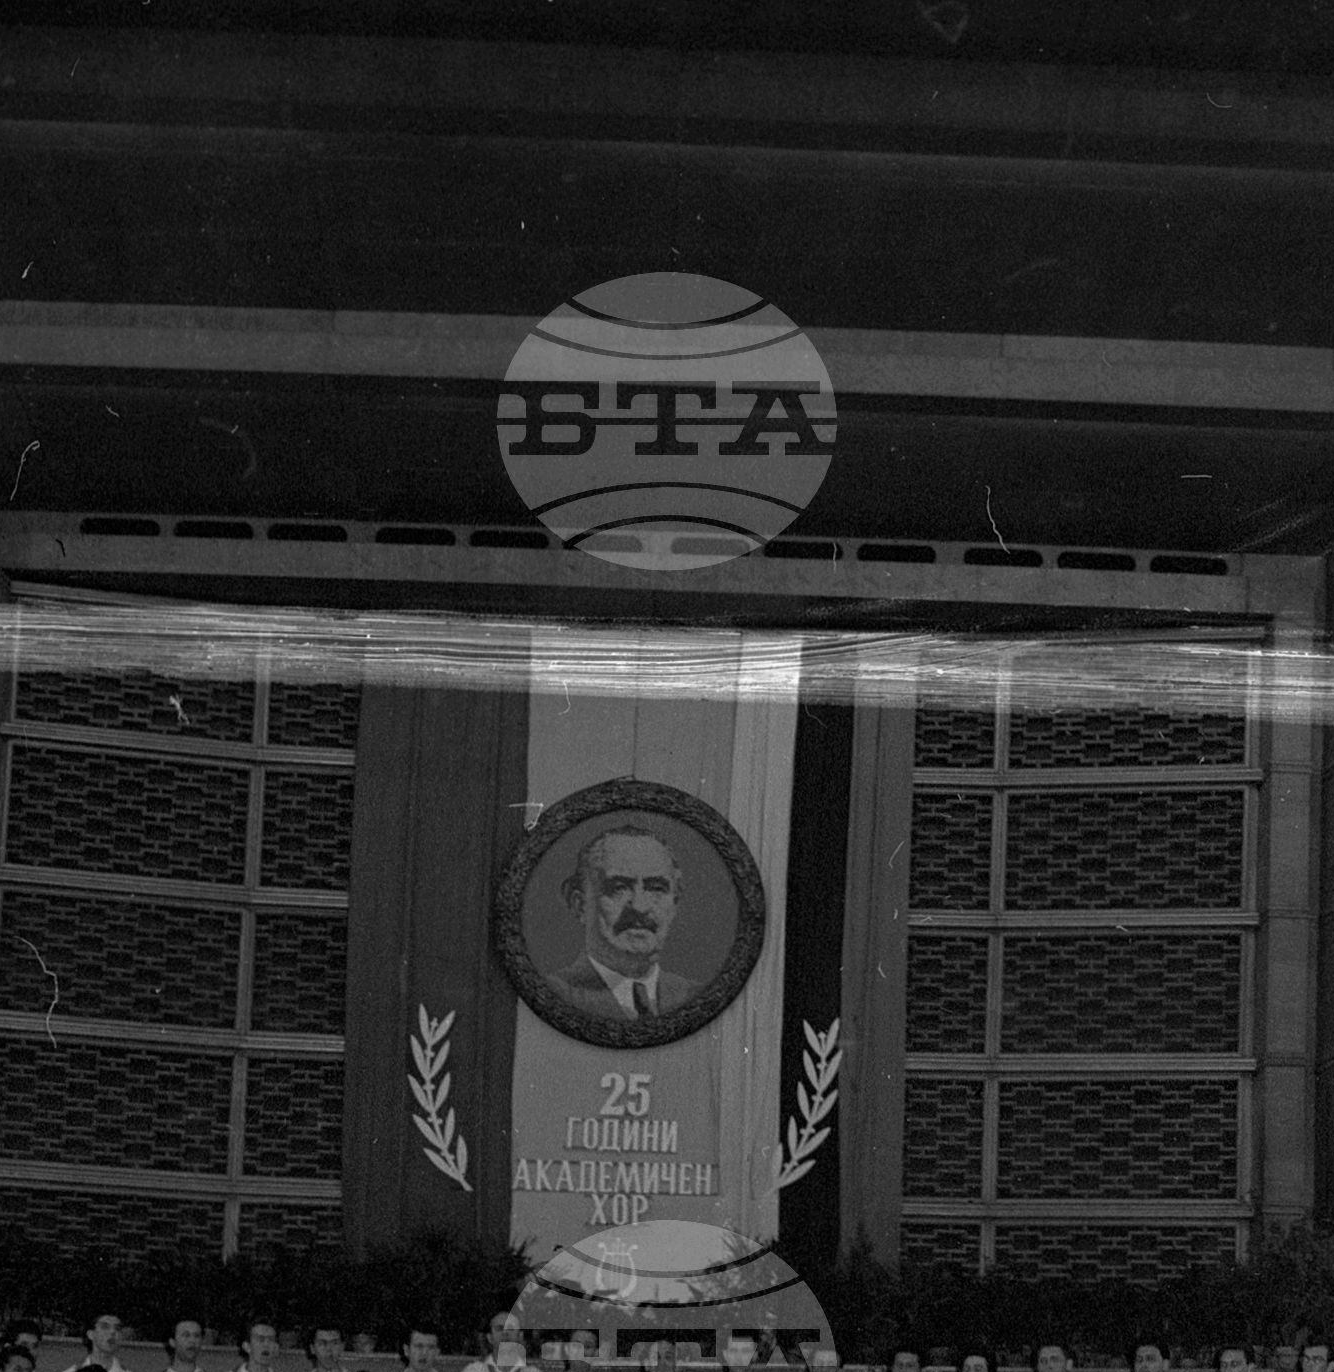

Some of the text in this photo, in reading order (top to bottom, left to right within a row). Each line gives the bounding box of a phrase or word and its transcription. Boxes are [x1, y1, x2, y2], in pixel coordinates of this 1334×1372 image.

[600, 1072, 652, 1117] 25
[566, 1117, 679, 1153] ГОДИНИ
[513, 1158, 713, 1196] АКАДЕМИЧЕН
[589, 1194, 650, 1226] ХОР
